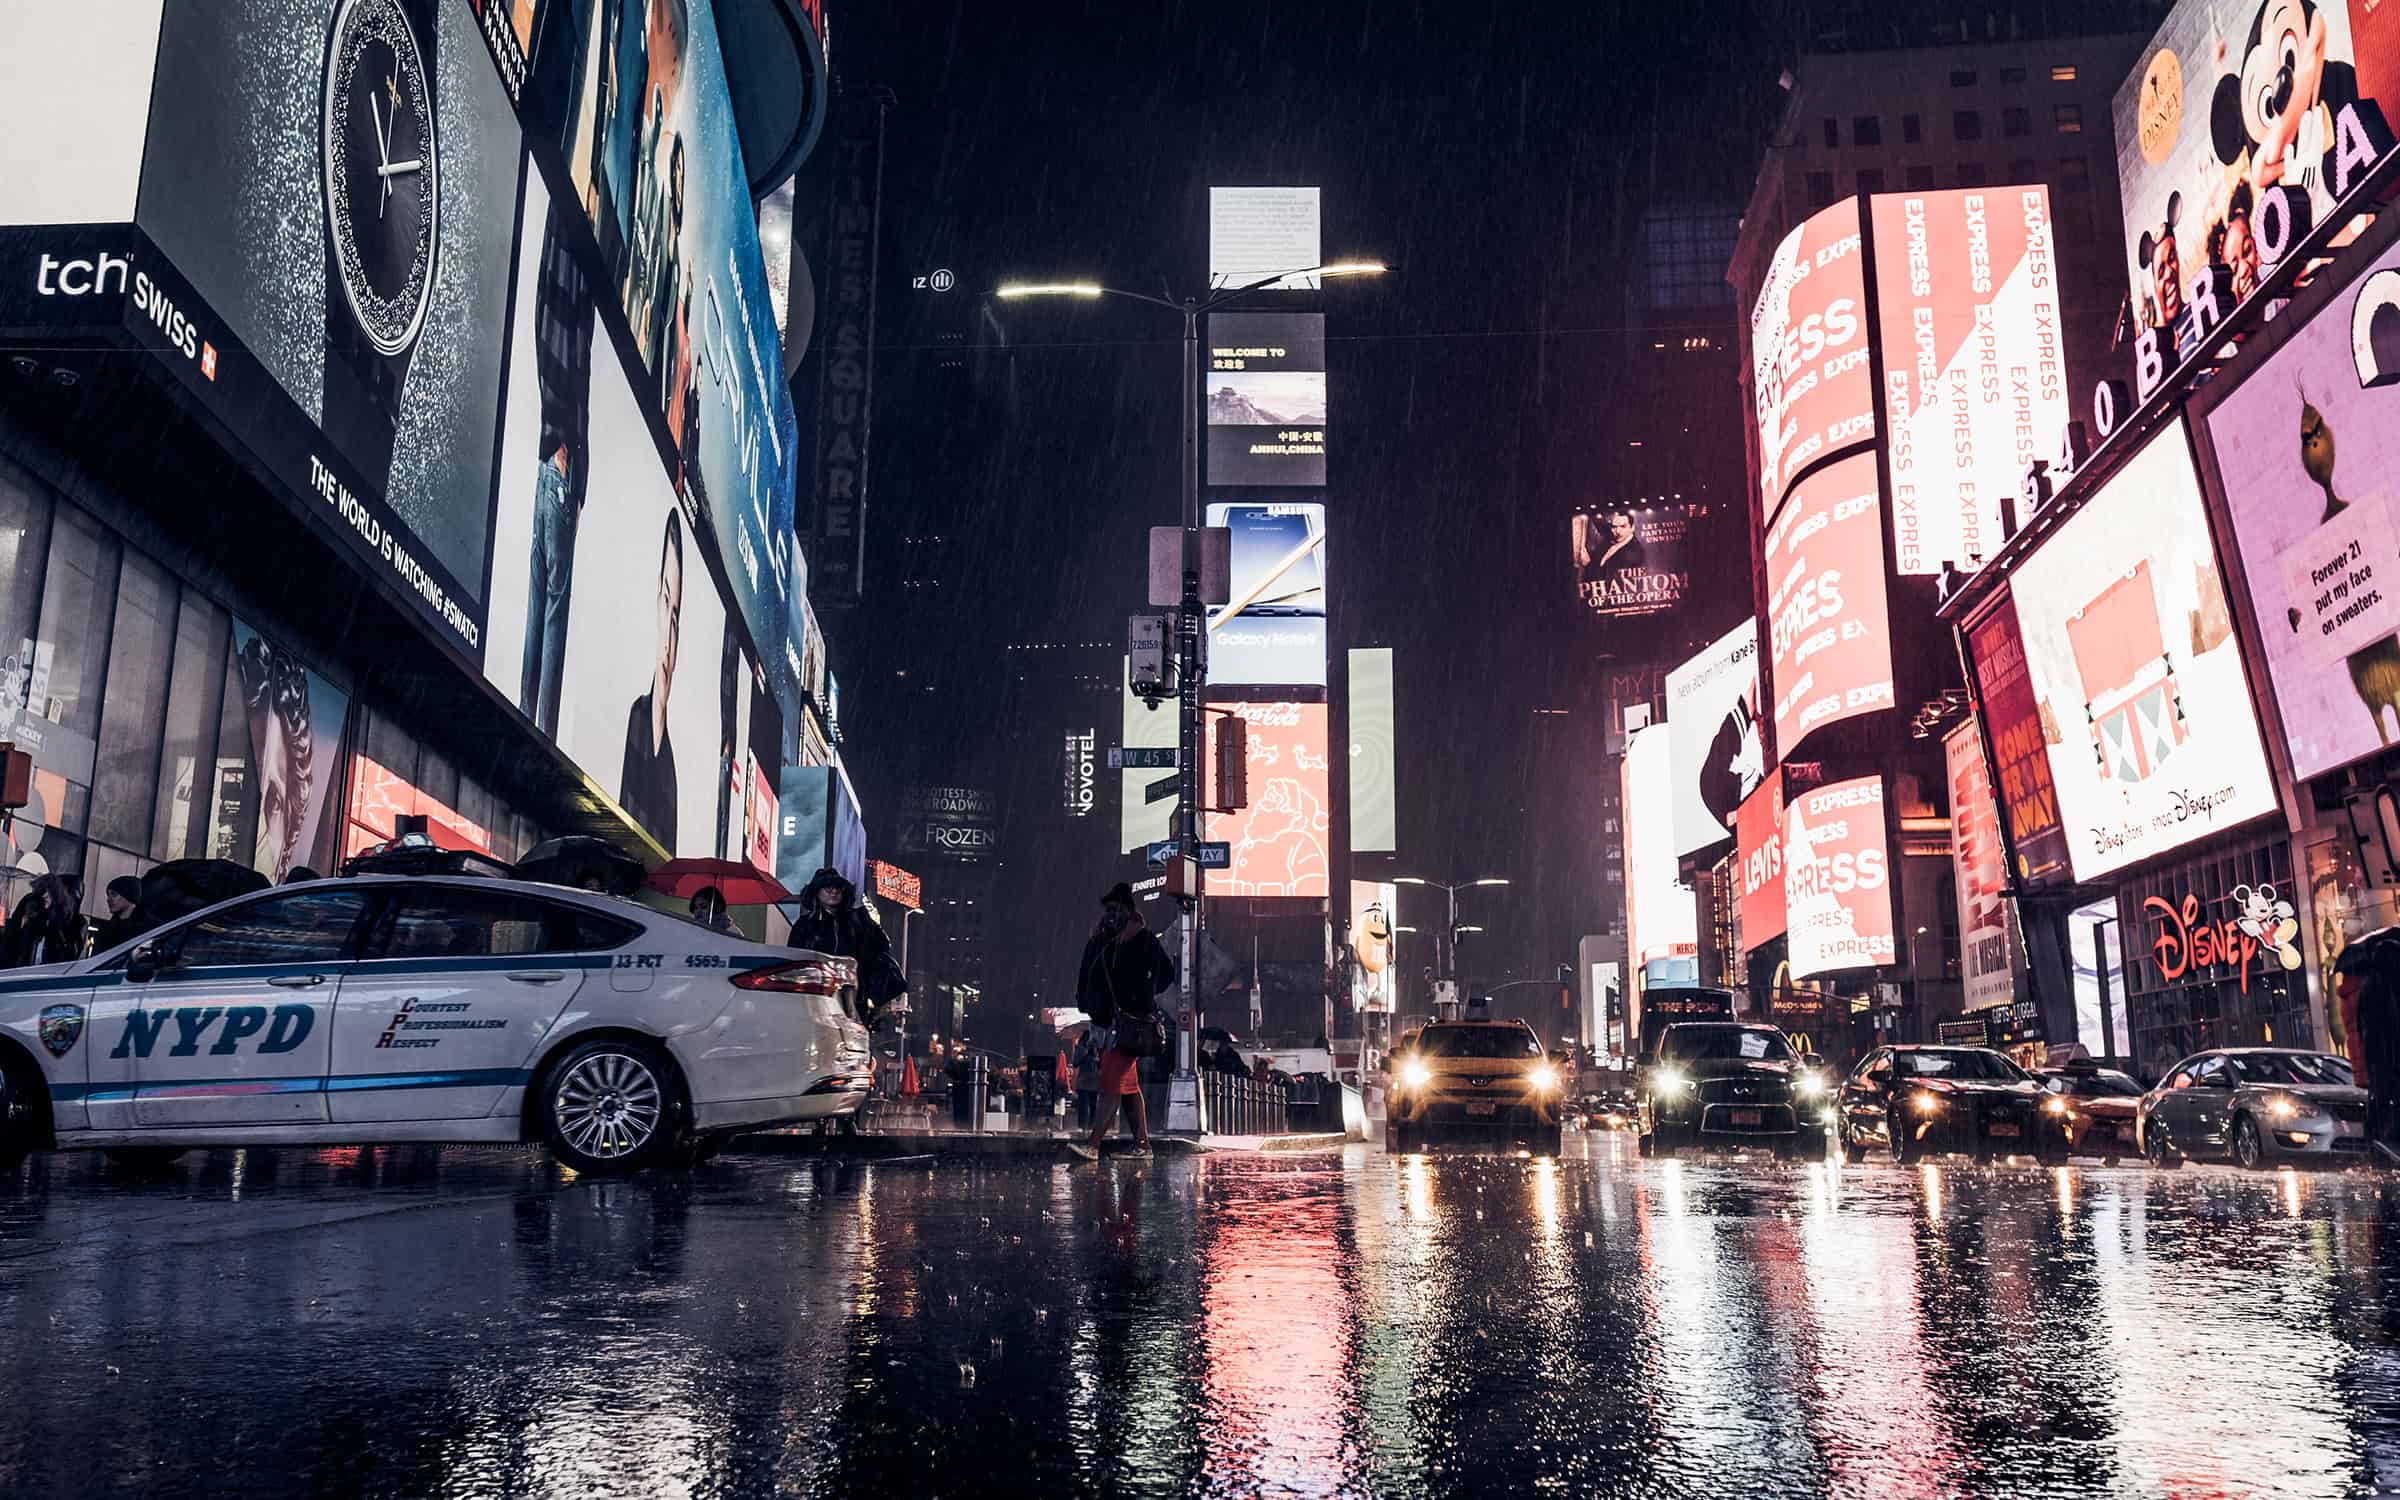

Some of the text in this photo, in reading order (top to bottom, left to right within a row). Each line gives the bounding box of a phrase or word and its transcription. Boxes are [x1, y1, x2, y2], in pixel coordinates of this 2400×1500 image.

[485, 10, 520, 101] MARQUIS
[1904, 198, 1931, 296] EXPRESS
[1965, 195, 1992, 294] EXPRESS
[2022, 191, 2049, 289] EXPRESS
[133, 272, 197, 359] SWISS
[1212, 348, 1286, 357] WELCOME TO
[1975, 304, 1999, 404] EXPRESS
[2034, 303, 2059, 401] EXPRESS
[827, 322, 863, 537] SQUARE
[1950, 368, 1973, 468] EXPRESS
[2010, 366, 2034, 466] EXPRESS
[311, 455, 336, 504] THE
[338, 484, 379, 546] WORLD
[381, 531, 391, 560] IS
[394, 543, 442, 612] WATCHING
[1578, 572, 1689, 598] PHANTOM
[1618, 567, 1647, 578] THE
[2311, 539, 2362, 587] Forever 21
[2315, 565, 2372, 616] put my face
[1587, 589, 1680, 608] OF THE OPERA
[2322, 589, 2383, 636] on sweaters.
[1216, 632, 1267, 650] Galaxy
[1731, 644, 1749, 664] Kane
[1126, 752, 1136, 766] W
[1144, 752, 1160, 766] 45
[1995, 714, 2043, 770] COME
[1077, 728, 1094, 816] NOVOTEL
[1810, 784, 1882, 815] EXPRESS
[926, 823, 994, 848] FROZEN
[1820, 925, 1894, 960] EXPRESS
[109, 1003, 315, 1059] NYPD
